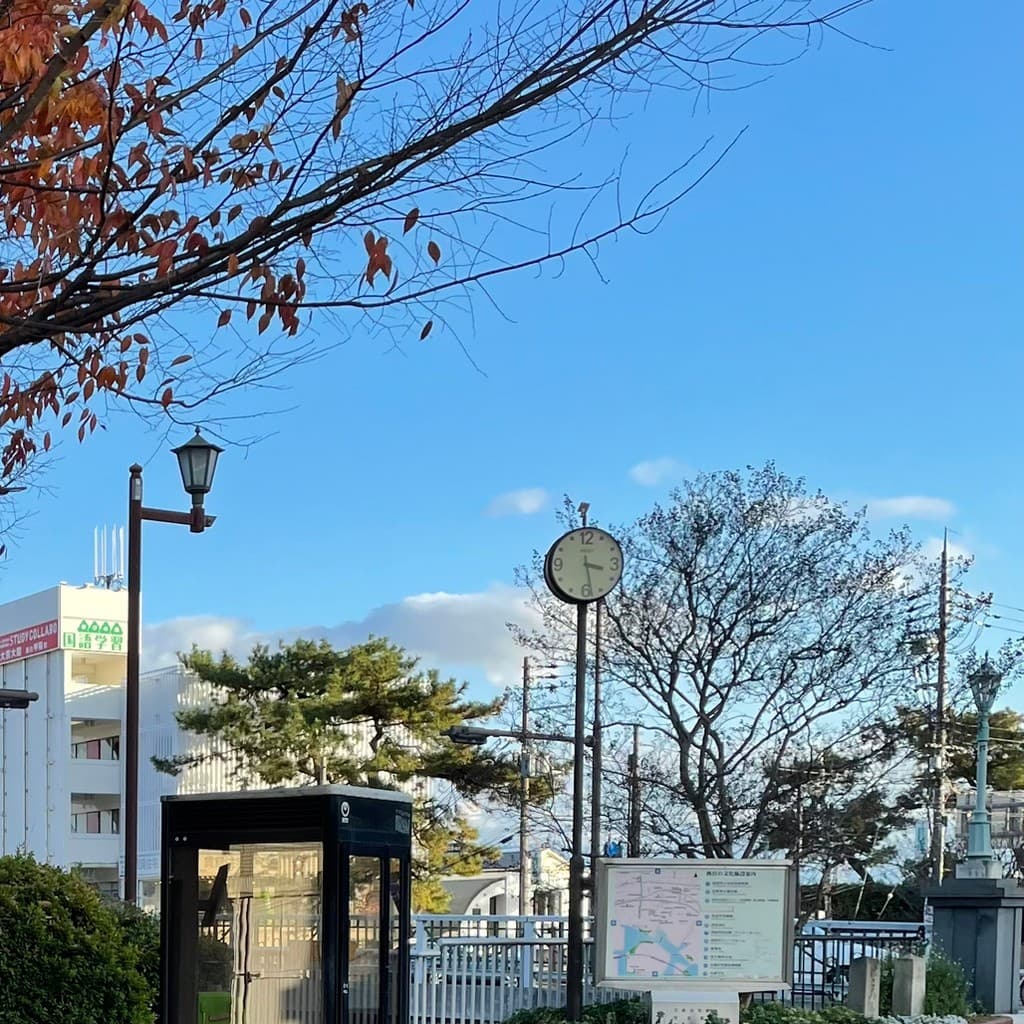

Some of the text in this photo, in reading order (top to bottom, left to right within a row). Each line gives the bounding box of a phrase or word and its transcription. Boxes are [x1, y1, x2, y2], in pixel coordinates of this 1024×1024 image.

[579, 531, 594, 545] 12
[553, 557, 563, 572] 9
[609, 556, 619, 571] 3
[581, 584, 591, 598] 6
[10, 631, 29, 647] STUDY
